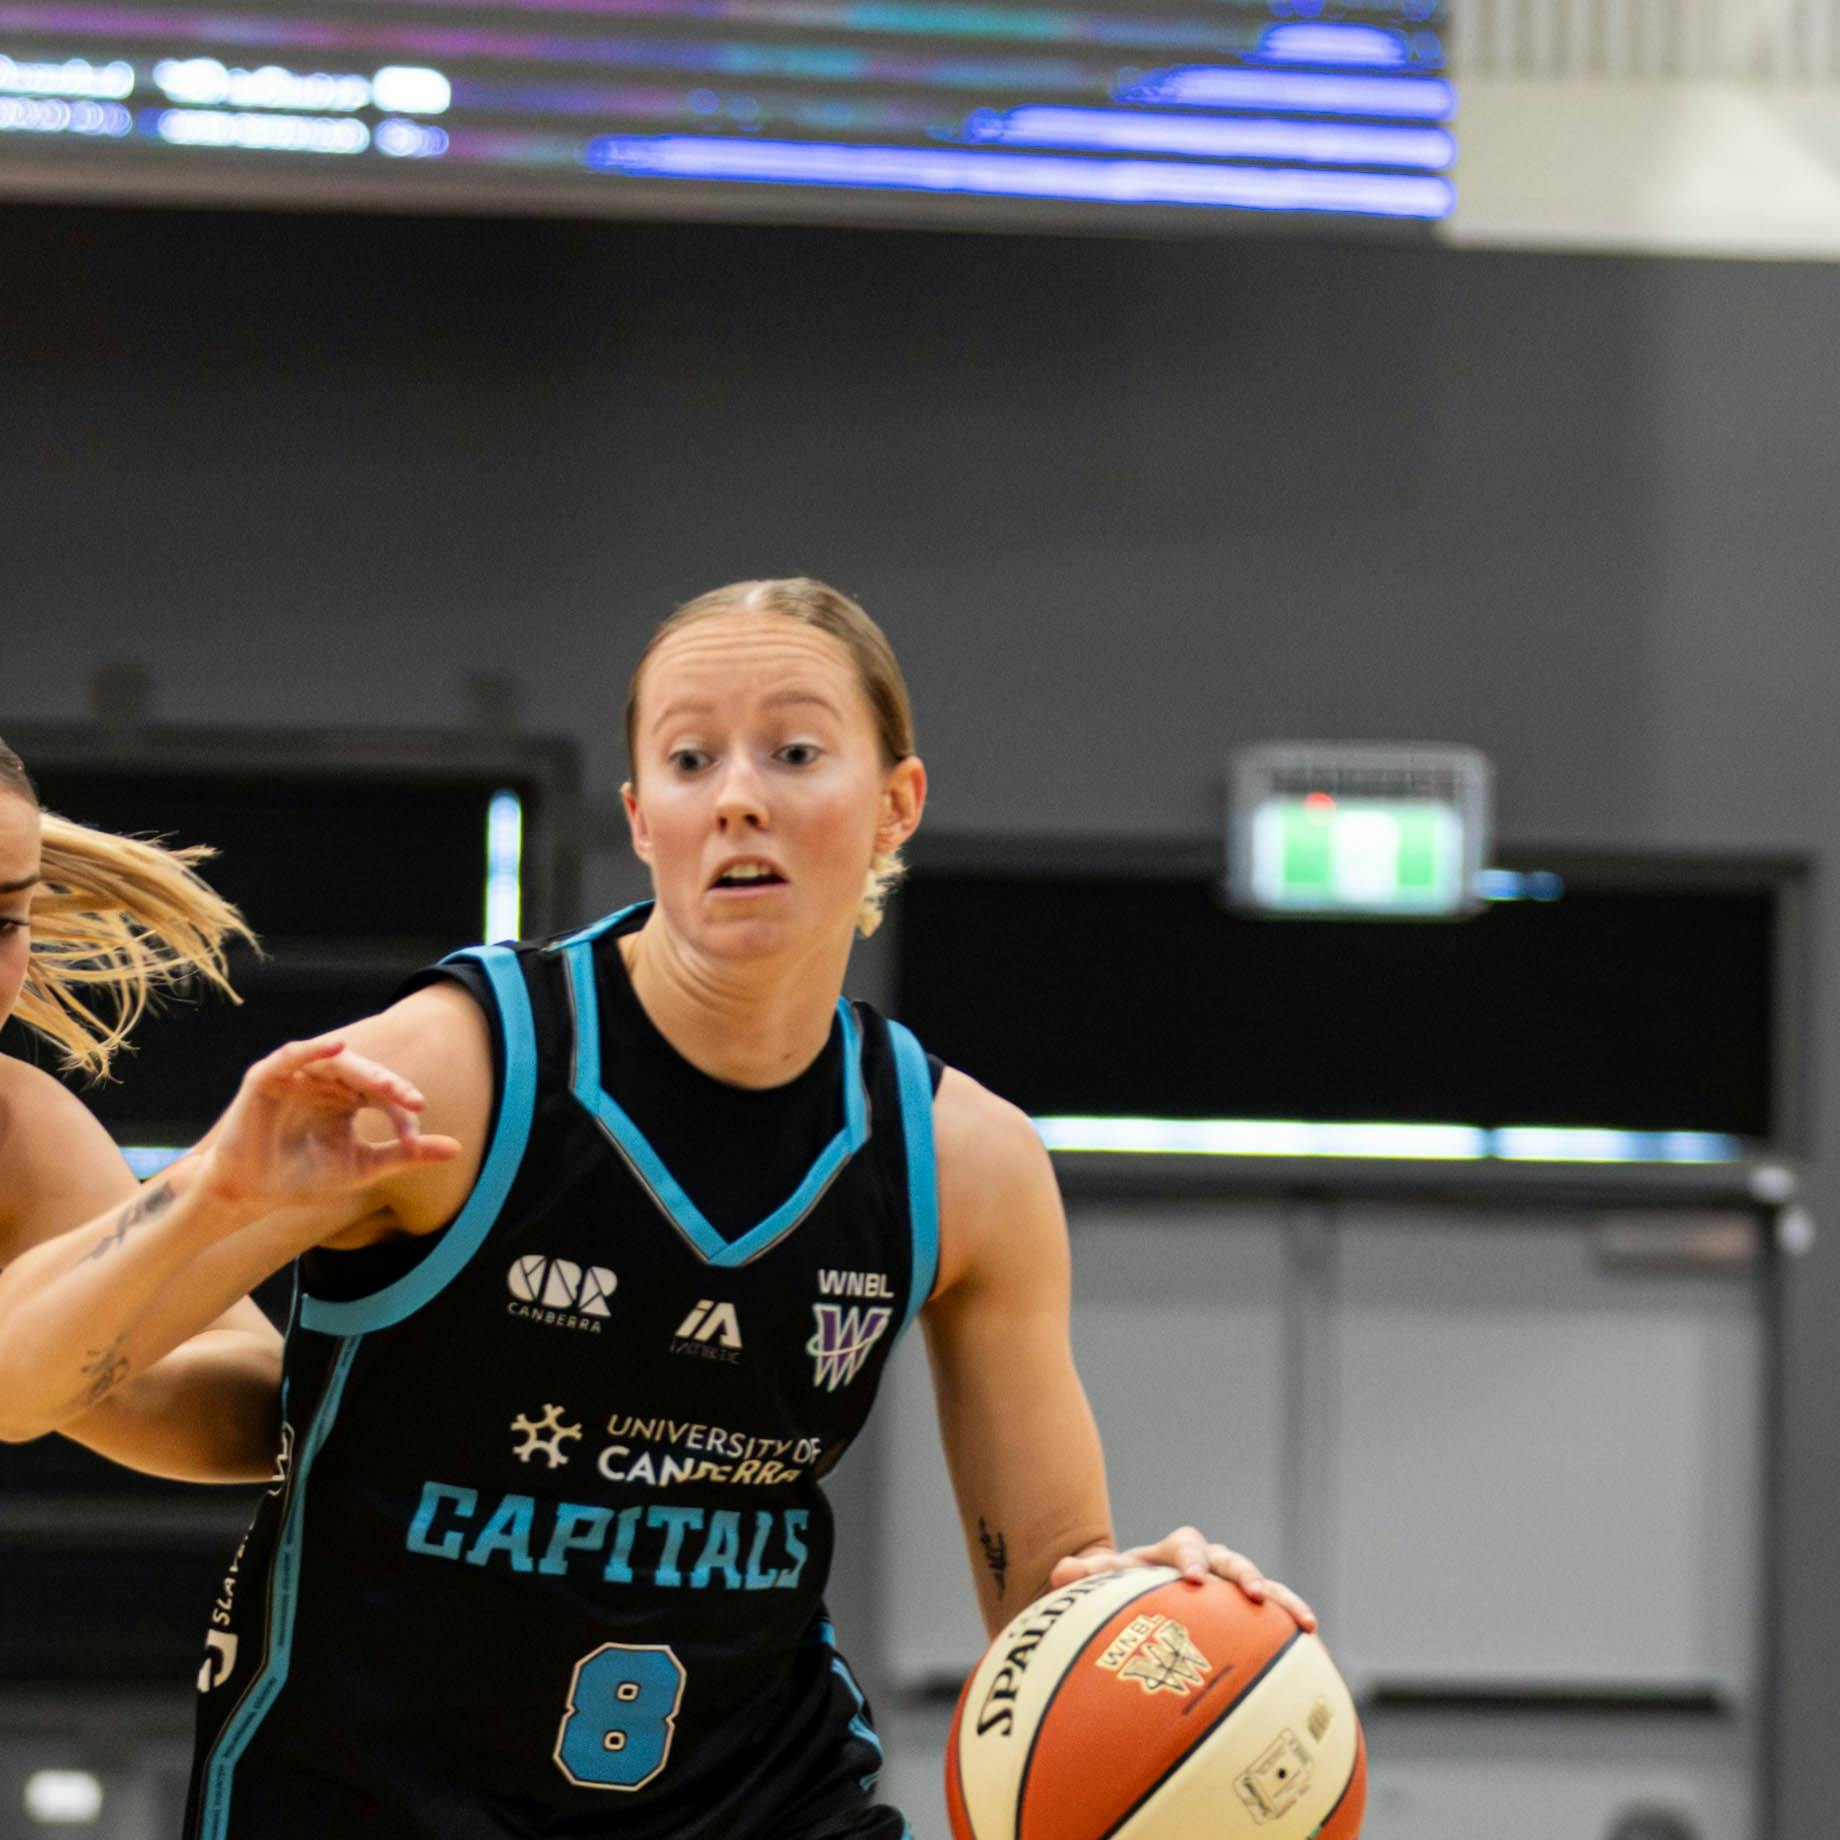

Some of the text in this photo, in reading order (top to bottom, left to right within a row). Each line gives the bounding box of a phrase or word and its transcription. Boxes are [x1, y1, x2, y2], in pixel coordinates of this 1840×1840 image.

[817, 1268, 895, 1299] WNBL
[506, 1300, 602, 1335] CANBERRA
[607, 1413, 792, 1460] UNIVERSITY
[404, 1480, 810, 1593] CAPITALS
[553, 1641, 690, 1792] 8
